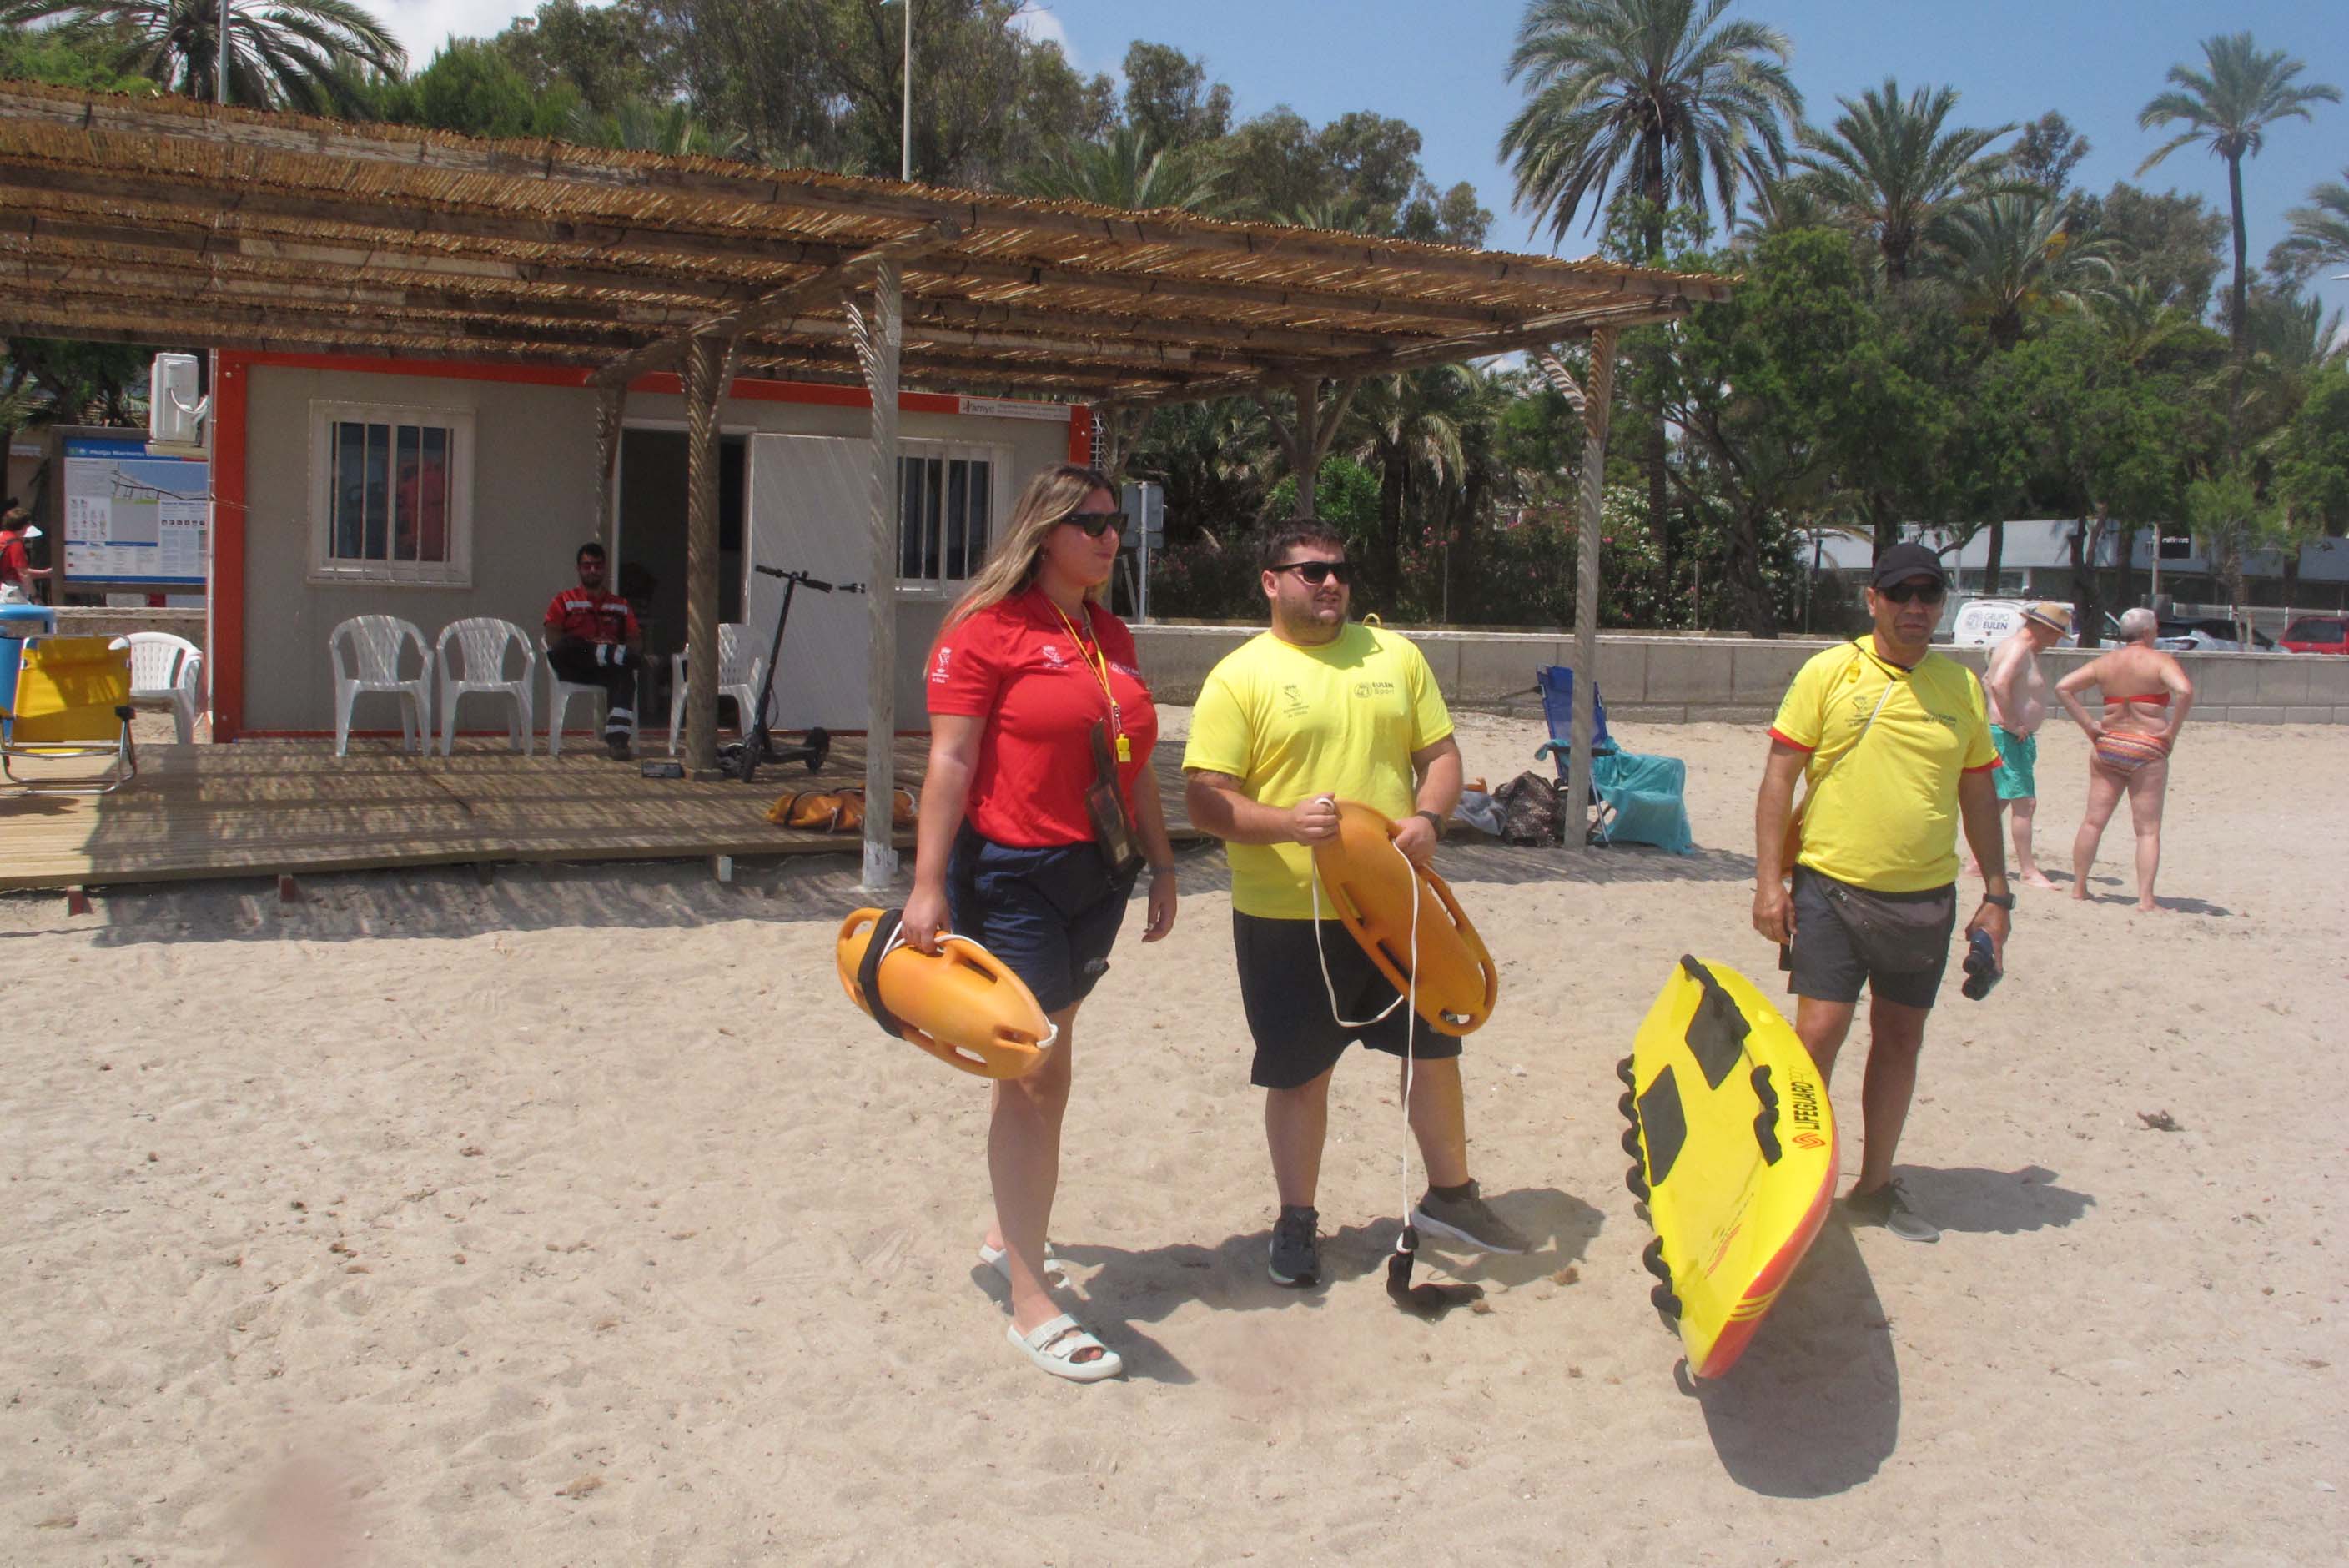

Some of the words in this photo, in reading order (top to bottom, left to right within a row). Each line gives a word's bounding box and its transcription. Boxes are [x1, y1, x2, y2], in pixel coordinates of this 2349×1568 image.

[1984, 613, 2010, 621] GRUPO
[1982, 621, 2009, 630] EULEN
[1791, 1081, 1820, 1130] LIFEGUARD
